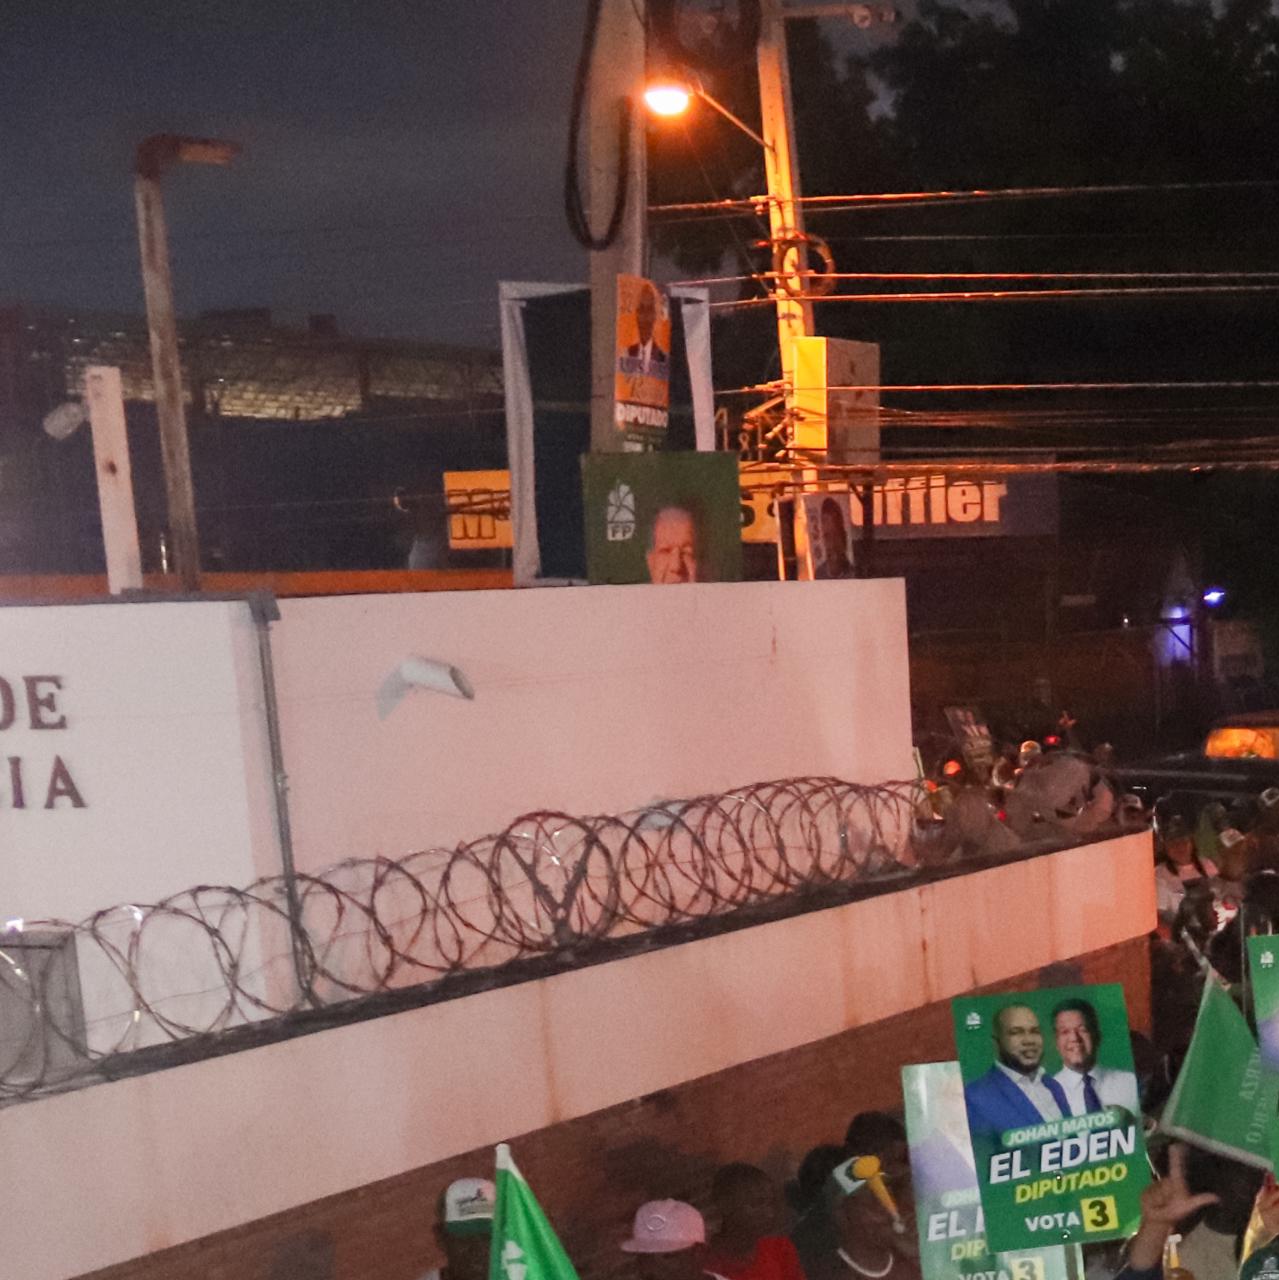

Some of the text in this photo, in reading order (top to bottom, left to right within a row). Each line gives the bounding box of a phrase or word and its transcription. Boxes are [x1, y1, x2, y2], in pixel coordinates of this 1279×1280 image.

[1005, 1110, 1115, 1146] JOHAN MATOS
[990, 1126, 1135, 1184] EL EDEN
[1015, 1164, 1128, 1204] DIPUTADO
[928, 1211, 966, 1241] EL
[1025, 1199, 1110, 1232] VOTA 3
